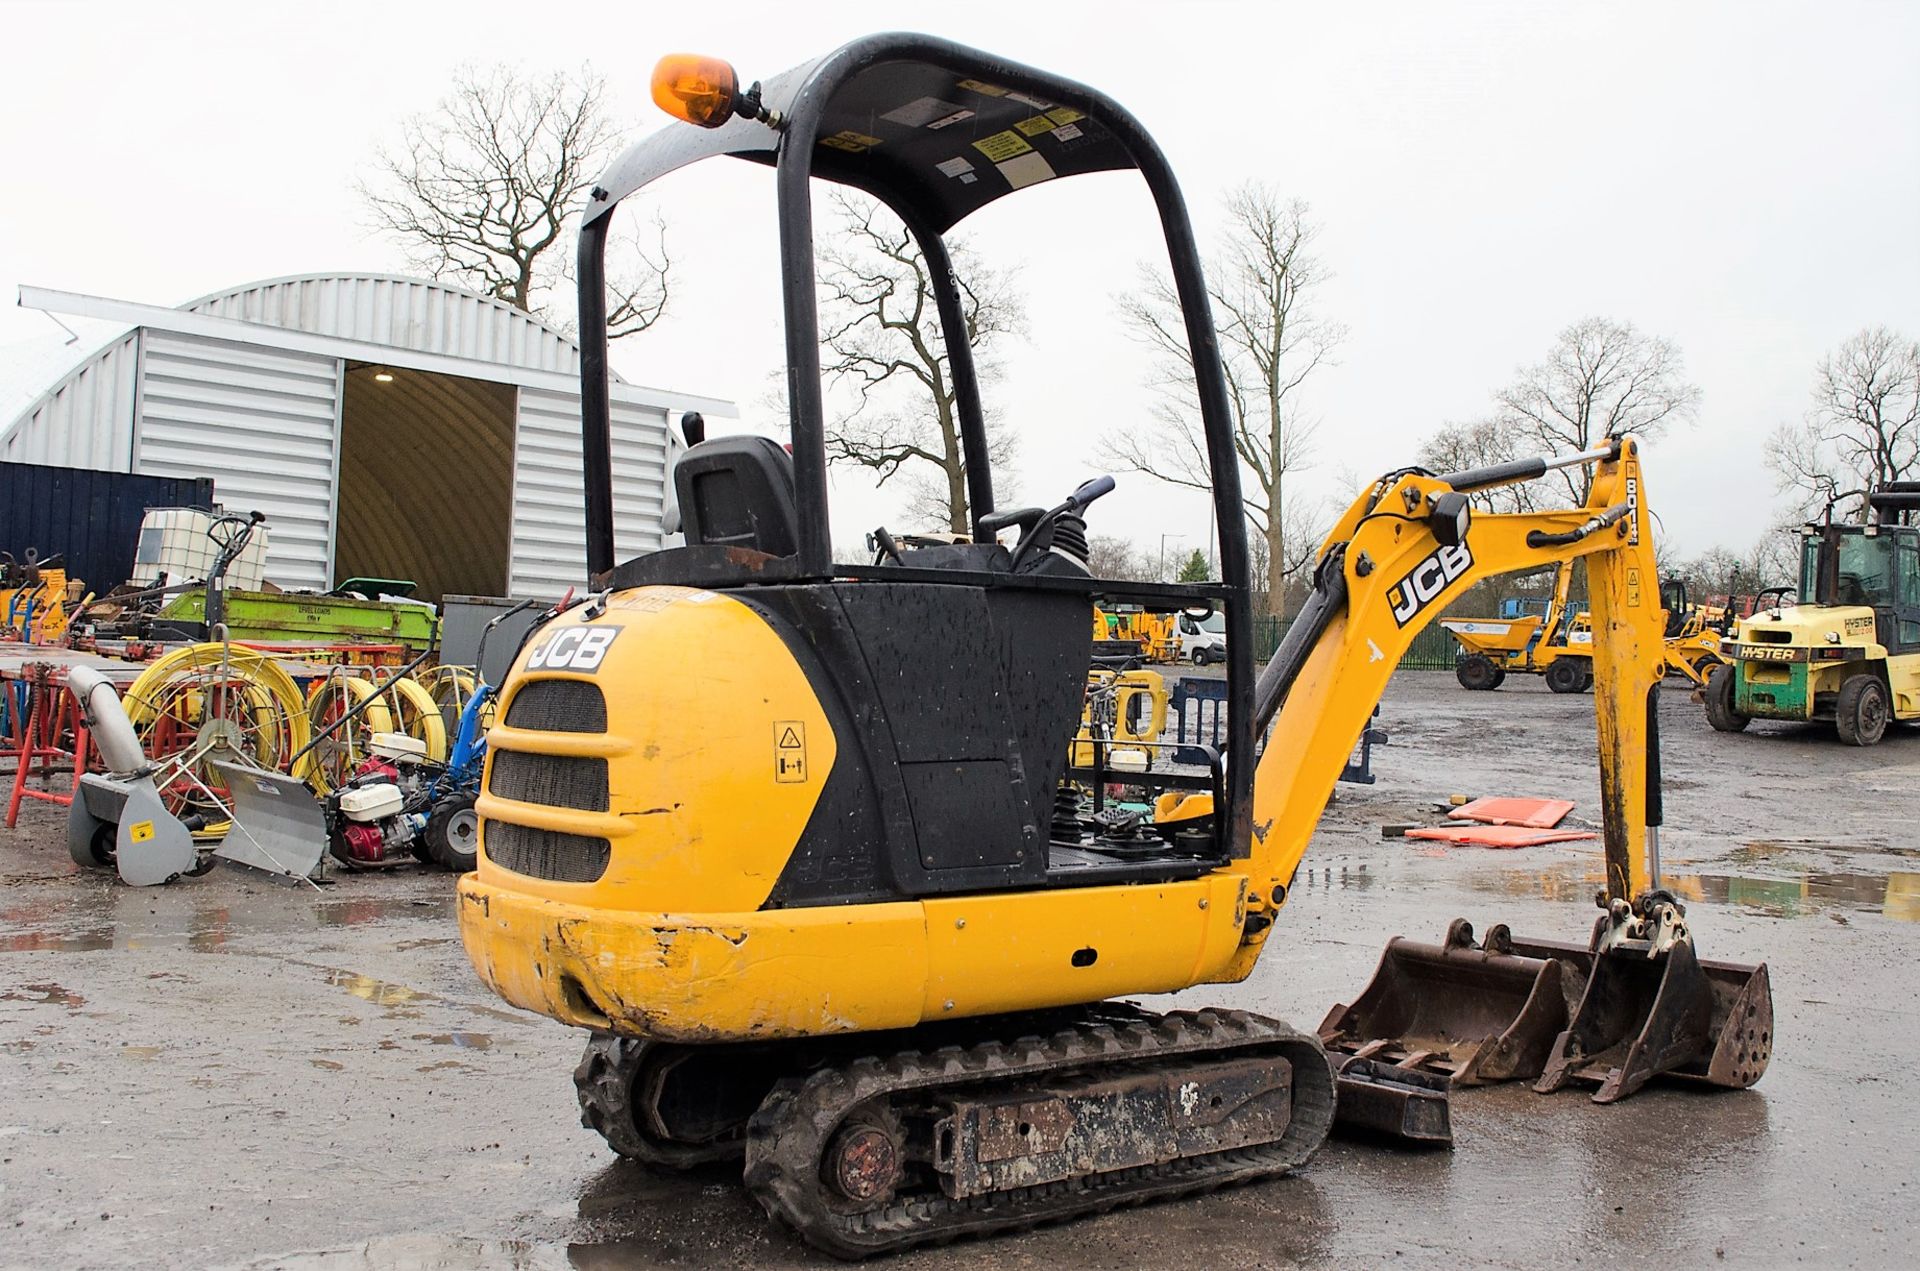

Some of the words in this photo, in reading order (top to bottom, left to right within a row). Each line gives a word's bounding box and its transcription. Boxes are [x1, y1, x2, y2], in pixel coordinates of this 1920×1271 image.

[1627, 479, 1638, 538] 8014
[1394, 541, 1471, 622] JCB
[1844, 617, 1873, 631] HYSTER
[528, 627, 616, 669] JCB
[1740, 646, 1796, 660] HYSTER
